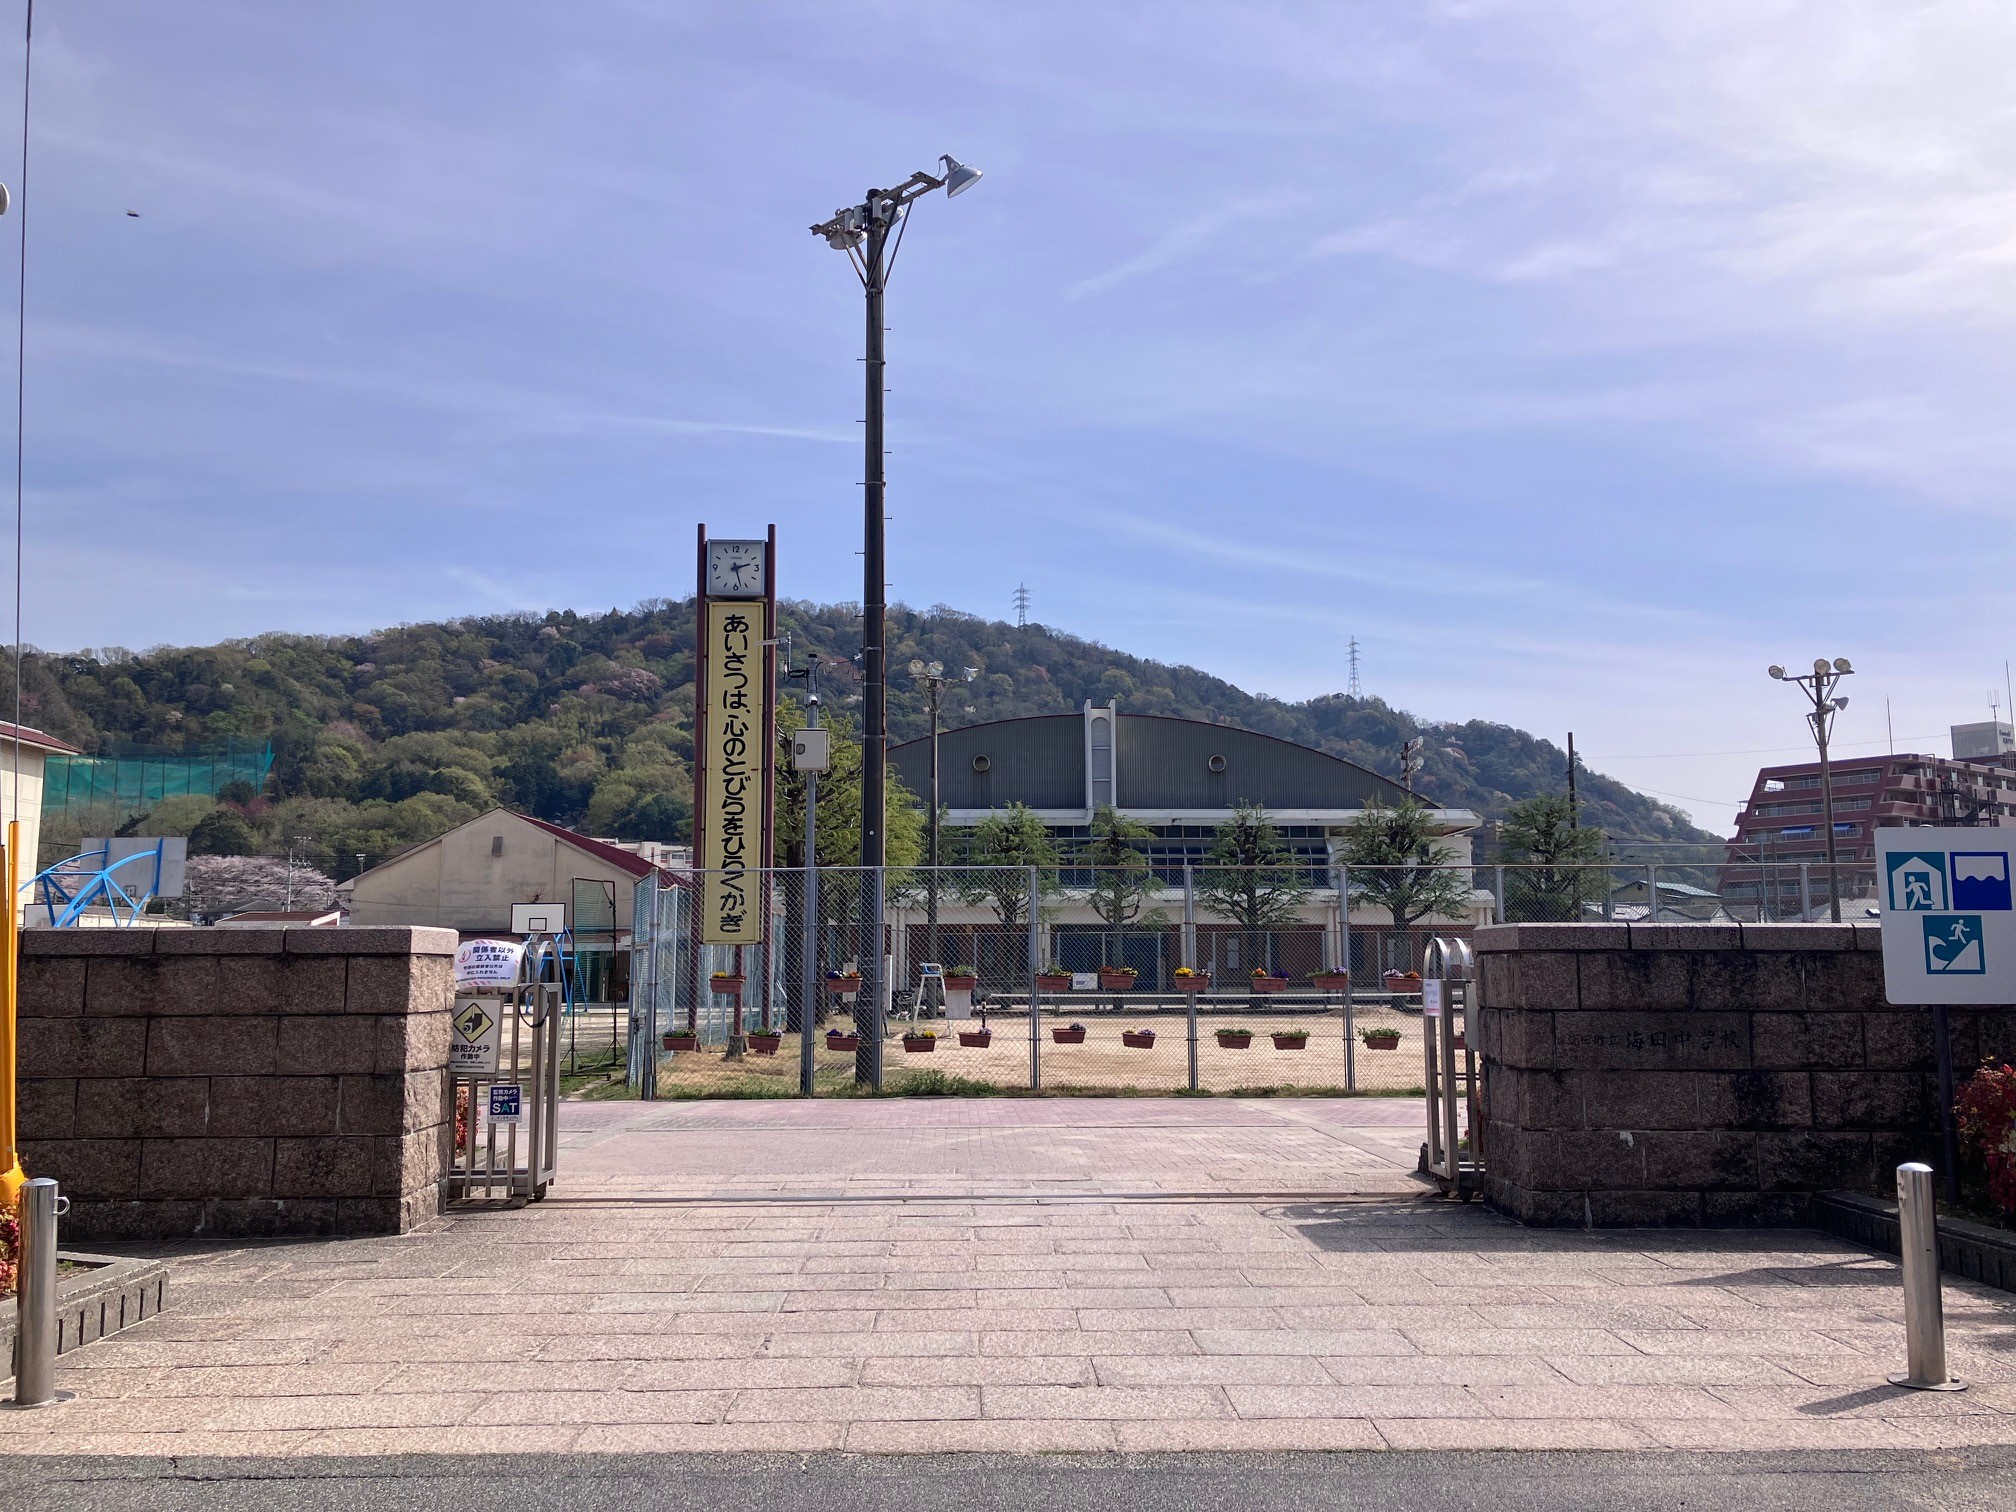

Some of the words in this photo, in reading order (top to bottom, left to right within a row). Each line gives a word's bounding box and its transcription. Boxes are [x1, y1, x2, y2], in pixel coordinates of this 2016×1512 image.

[732, 545, 740, 553] 12
[712, 563, 718, 572] 9
[754, 564, 760, 572] 3
[733, 583, 739, 591] 6
[720, 613, 751, 933] あいさつは、心のとびらをひらくかぎ
[472, 946, 514, 954] 関係者以外
[475, 954, 509, 962] 立入禁止
[451, 1044, 491, 1053] 防犯カメラ
[492, 1102, 518, 1113] SAT
